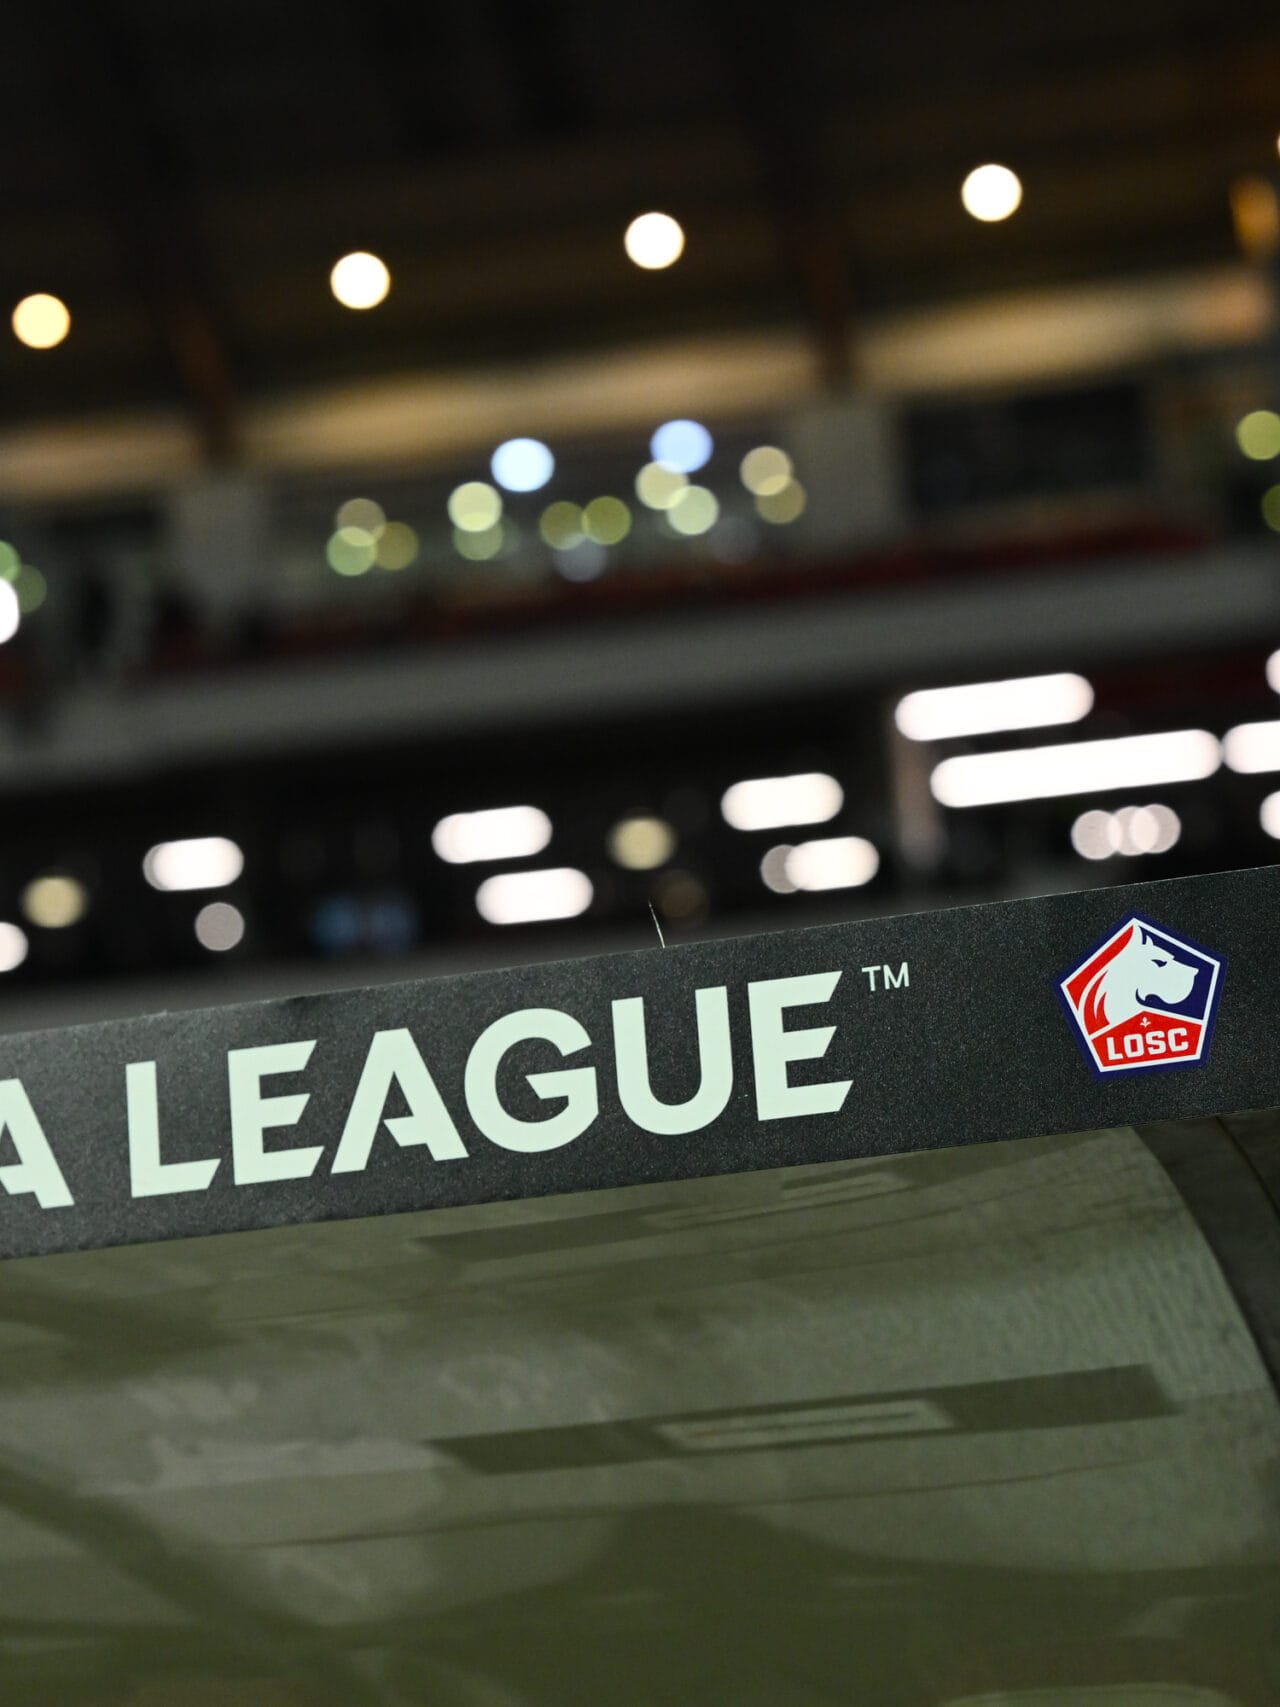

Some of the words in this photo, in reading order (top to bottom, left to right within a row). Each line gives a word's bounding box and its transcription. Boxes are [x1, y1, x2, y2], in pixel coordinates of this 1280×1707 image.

[125, 970, 854, 1199] LEAGUE
[861, 961, 910, 992] TM
[1106, 1027, 1189, 1061] LOSC
